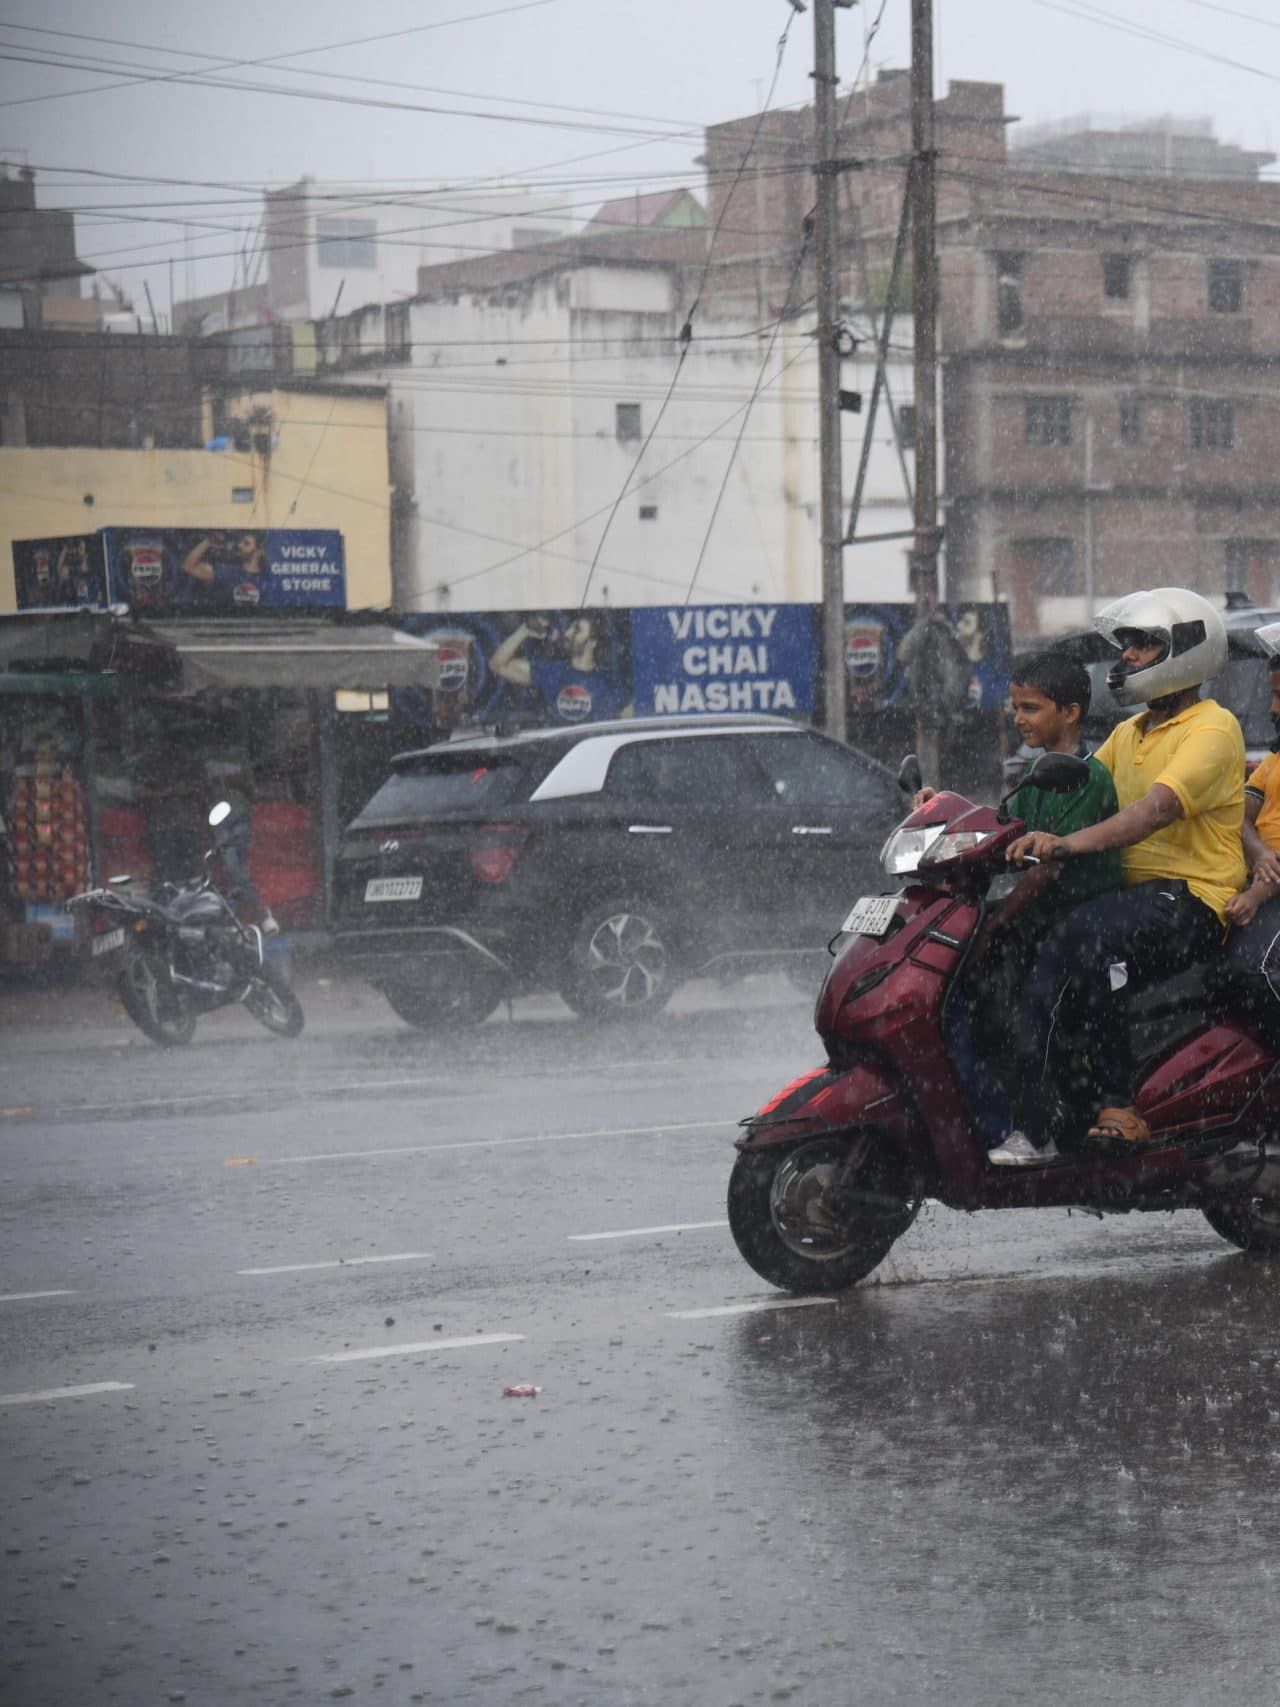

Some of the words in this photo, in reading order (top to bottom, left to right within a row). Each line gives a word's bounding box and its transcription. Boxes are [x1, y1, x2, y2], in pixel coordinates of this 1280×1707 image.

[280, 545, 327, 559] VICKY
[271, 562, 340, 576] GENERAL
[281, 578, 331, 592] STORE
[667, 608, 777, 640] VICKY
[682, 645, 769, 677] CHAI
[653, 680, 797, 713] NASHTA
